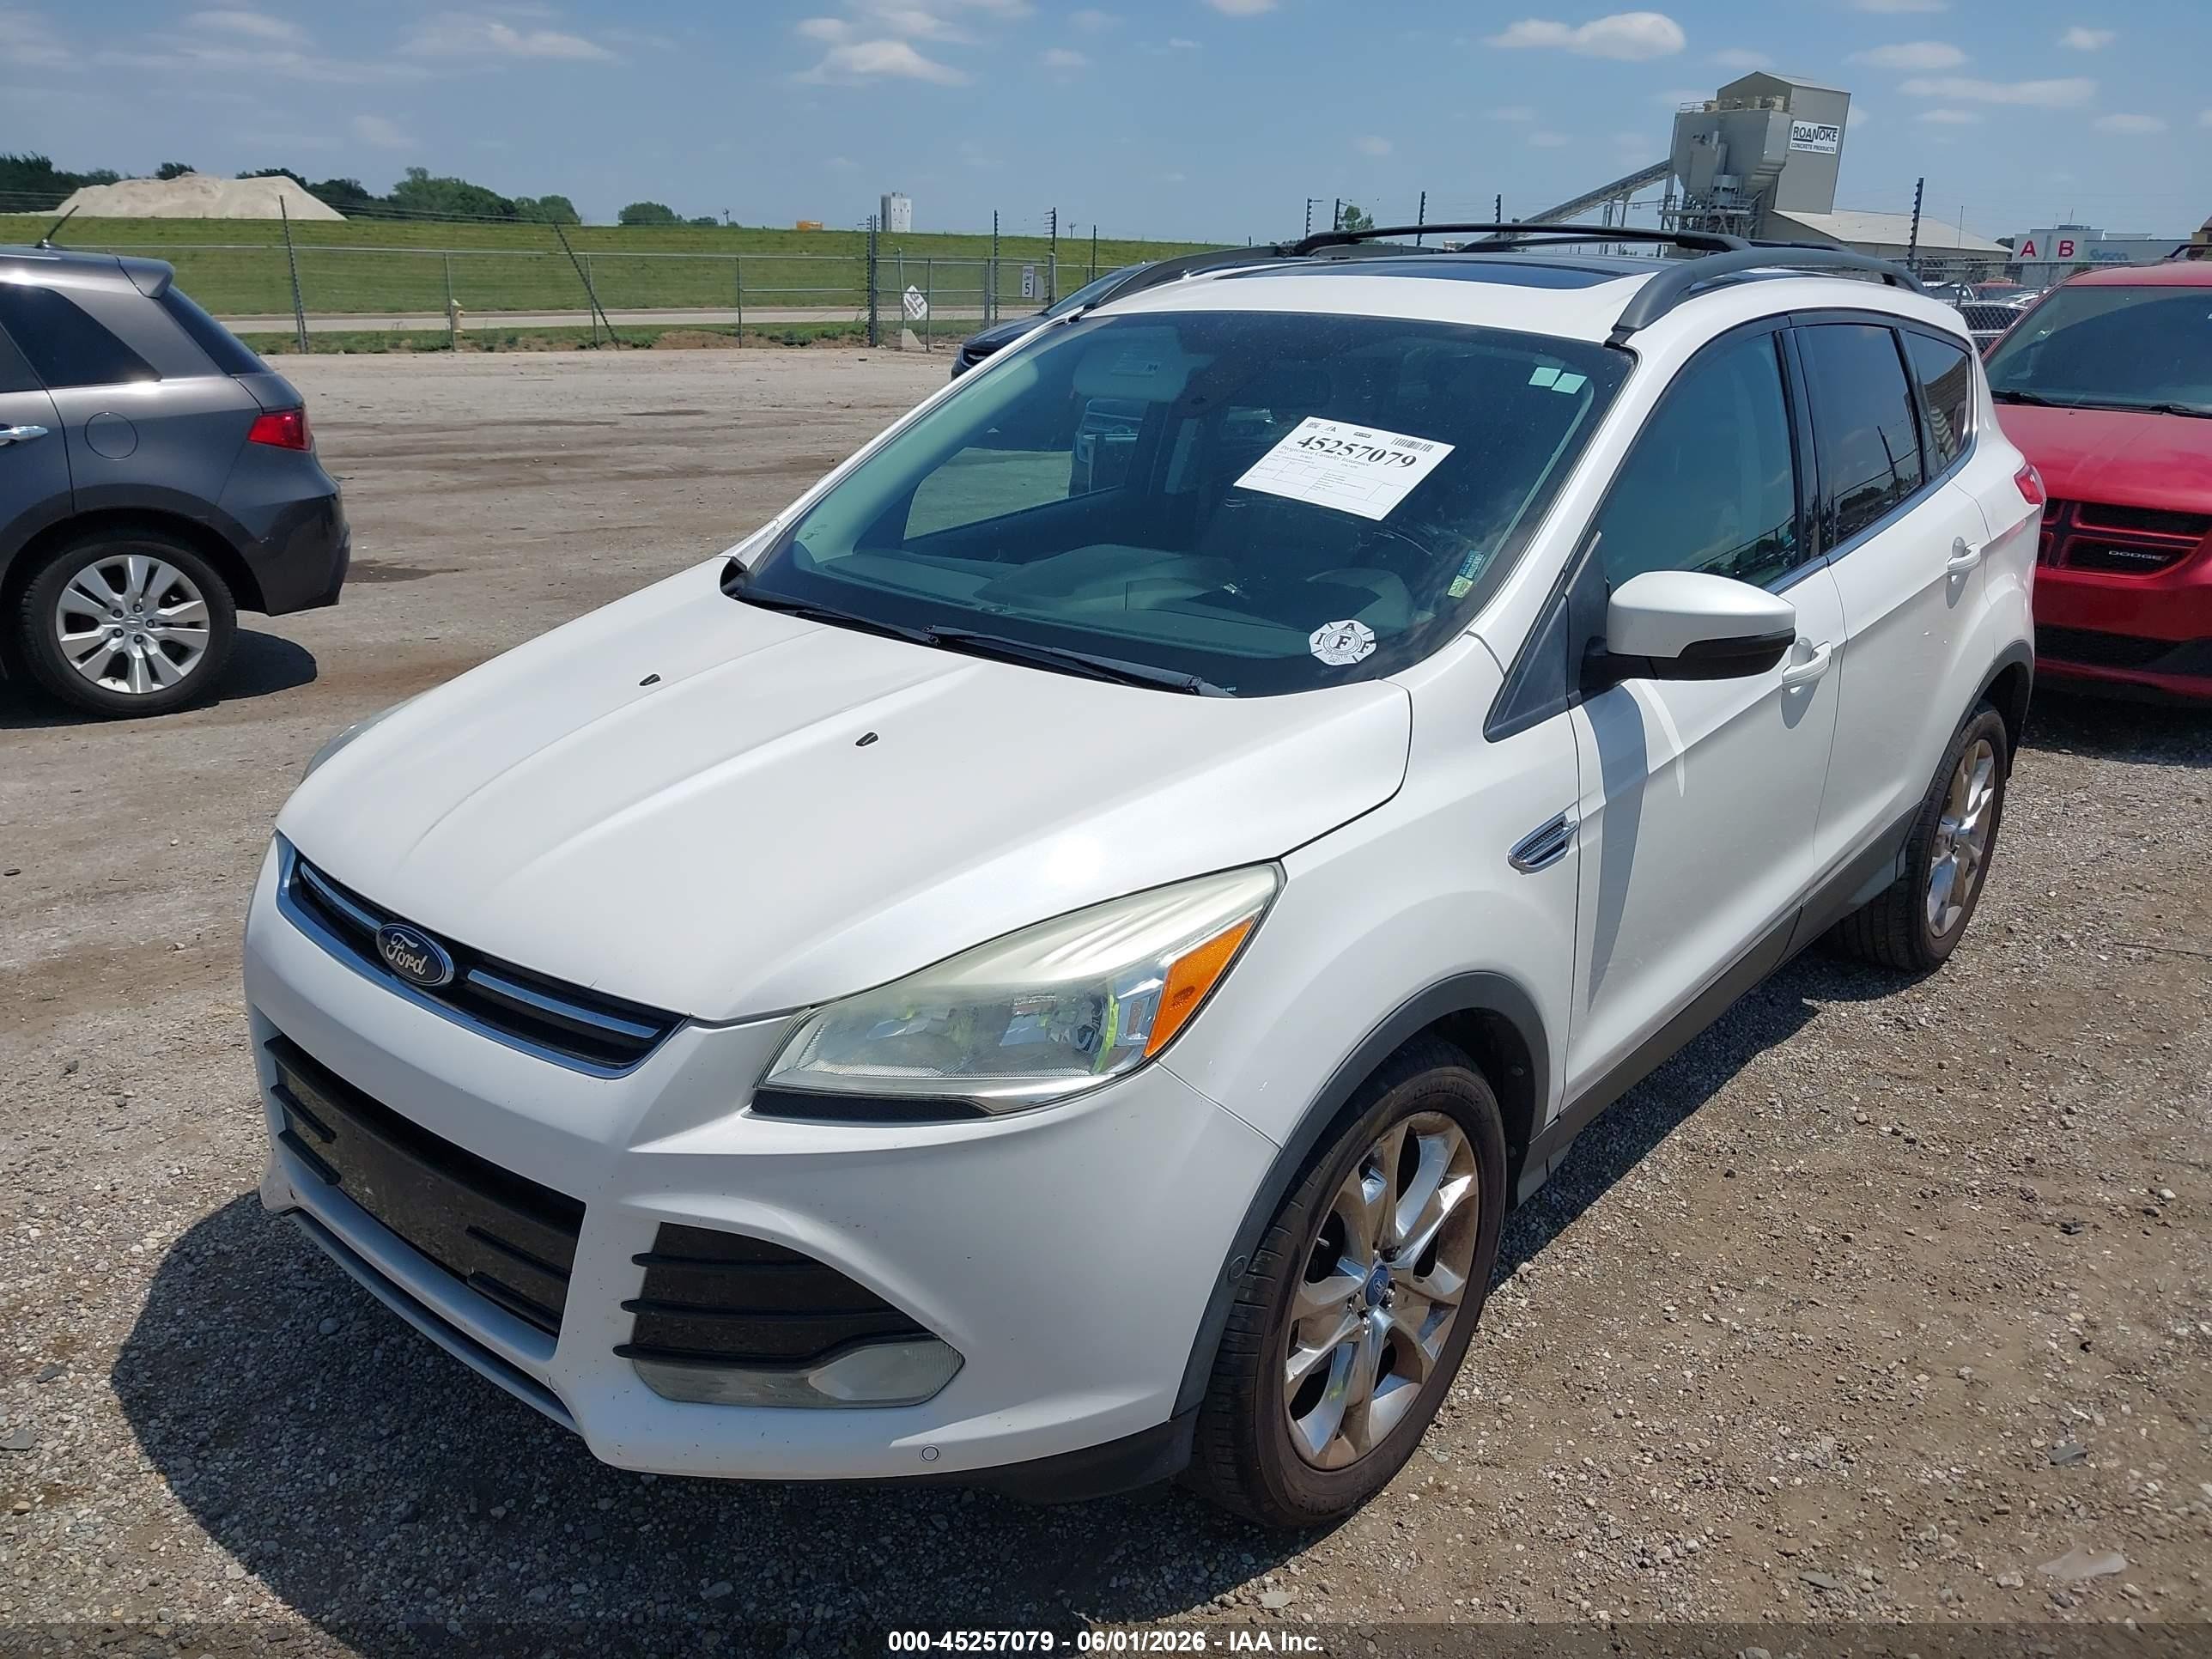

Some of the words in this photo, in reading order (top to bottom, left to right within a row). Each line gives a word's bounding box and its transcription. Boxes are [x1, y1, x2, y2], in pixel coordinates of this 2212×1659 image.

[1792, 126, 1838, 142] ROANOKE
[2020, 240, 2037, 257] A
[2057, 240, 2075, 257] B
[1024, 283, 1030, 295] 5
[1296, 434, 1417, 468] 45257079
[2108, 550, 2163, 561] DODGE
[386, 933, 428, 975] Ford
